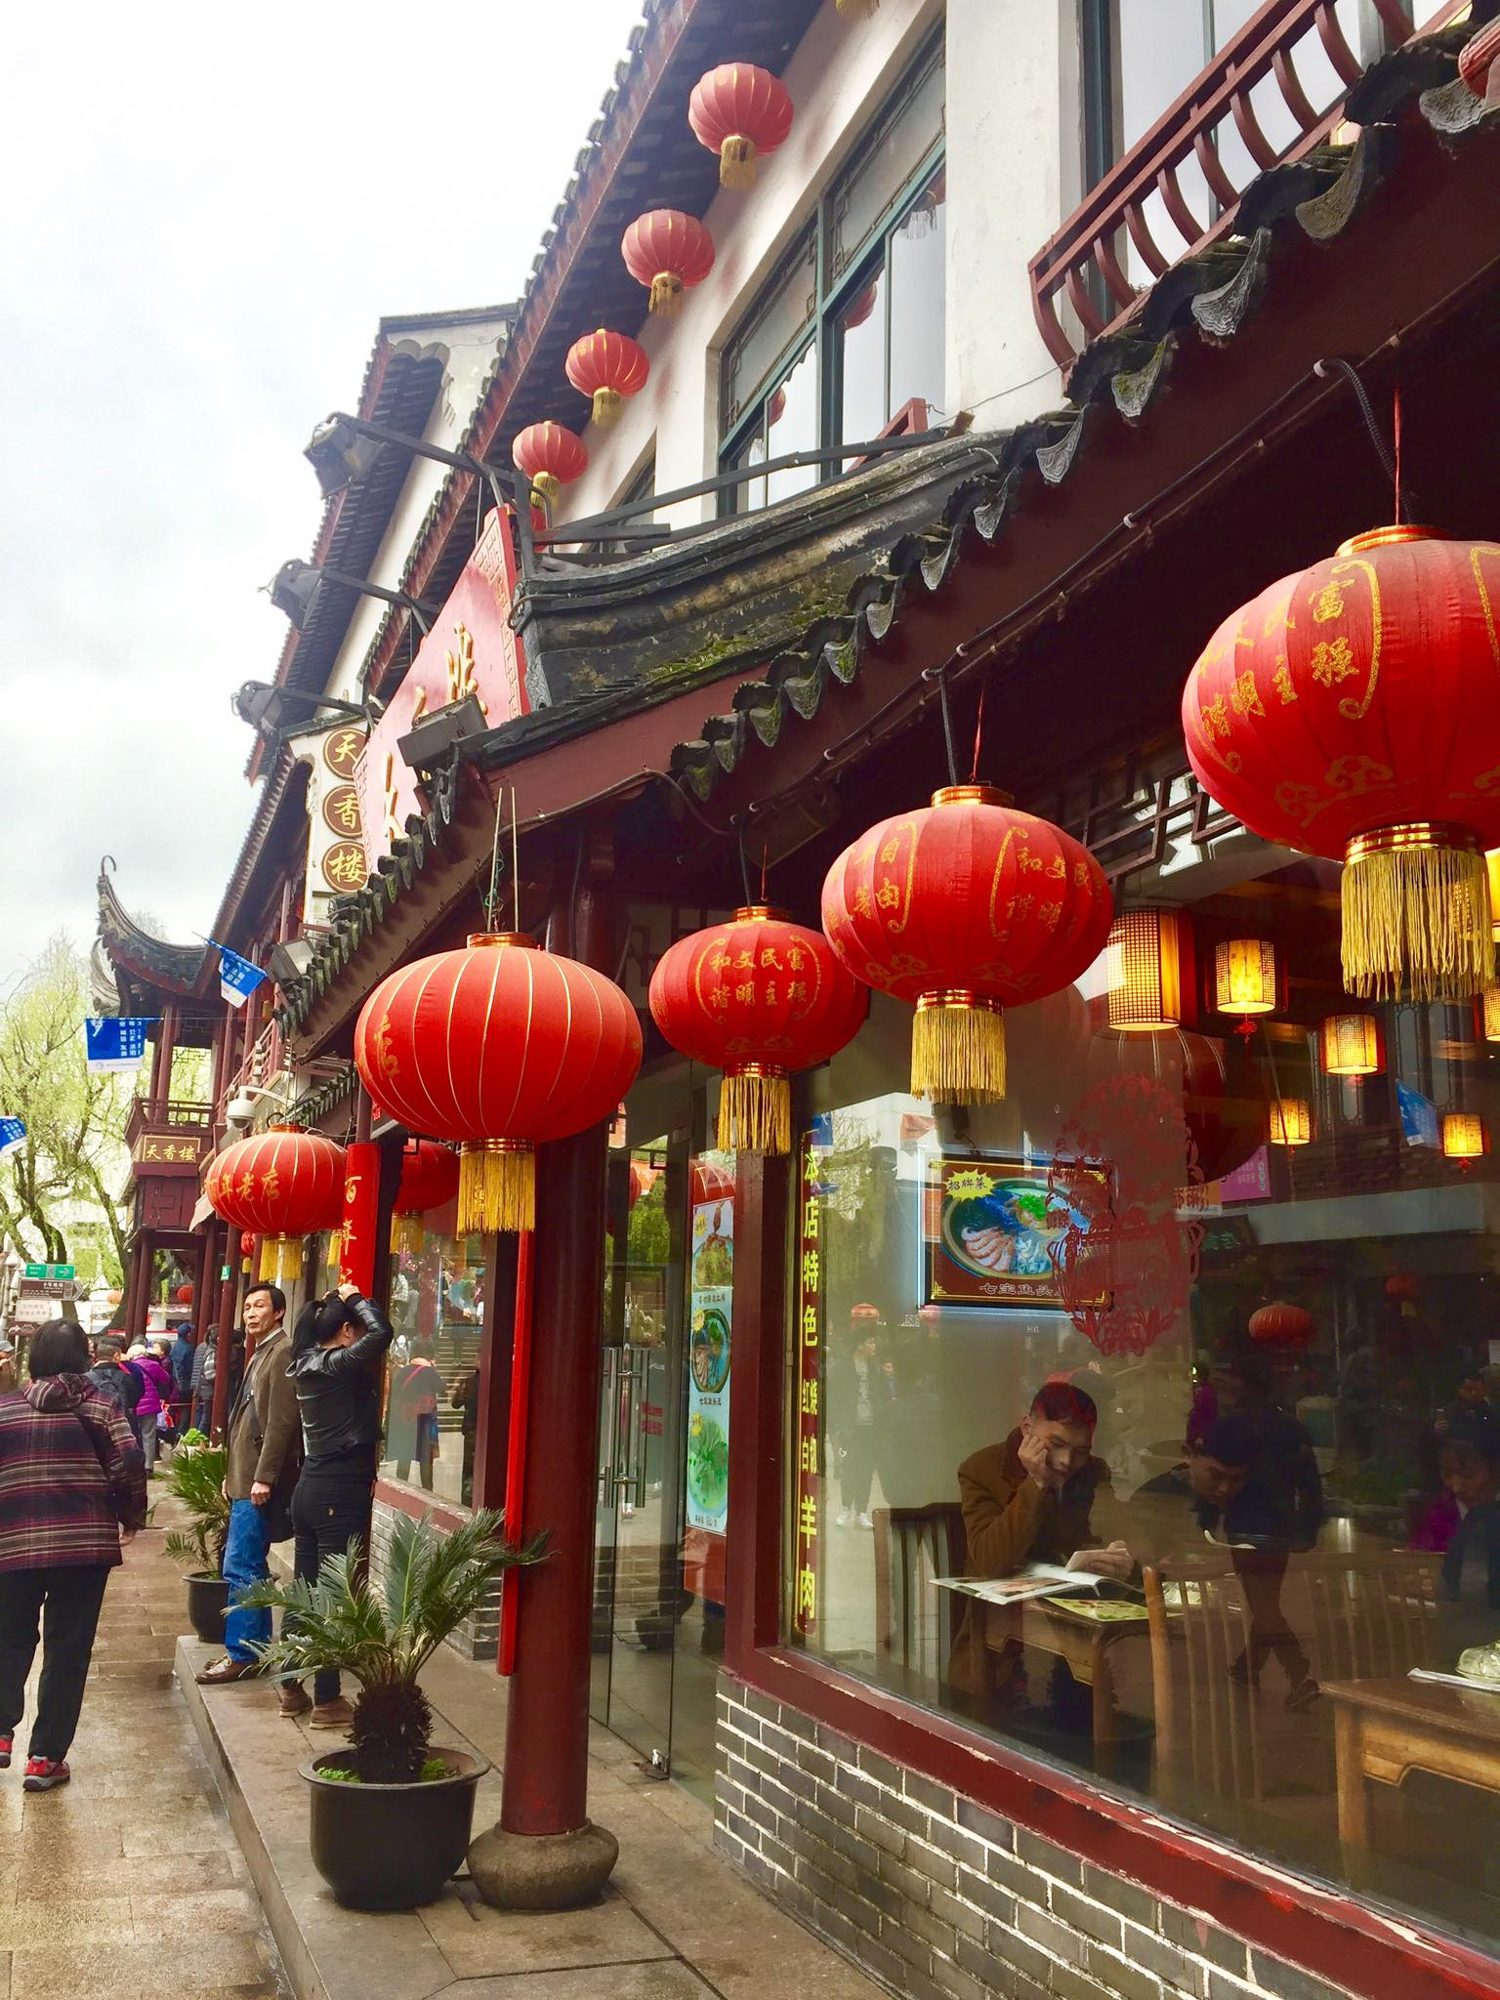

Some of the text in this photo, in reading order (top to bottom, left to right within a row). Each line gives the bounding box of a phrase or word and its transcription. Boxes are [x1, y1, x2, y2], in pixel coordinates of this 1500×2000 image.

[328, 732, 369, 885] 天香楼
[146, 1143, 196, 1161] 天香楼
[803, 1144, 820, 1348] 本店特色
[800, 1494, 817, 1620] 羊肉
